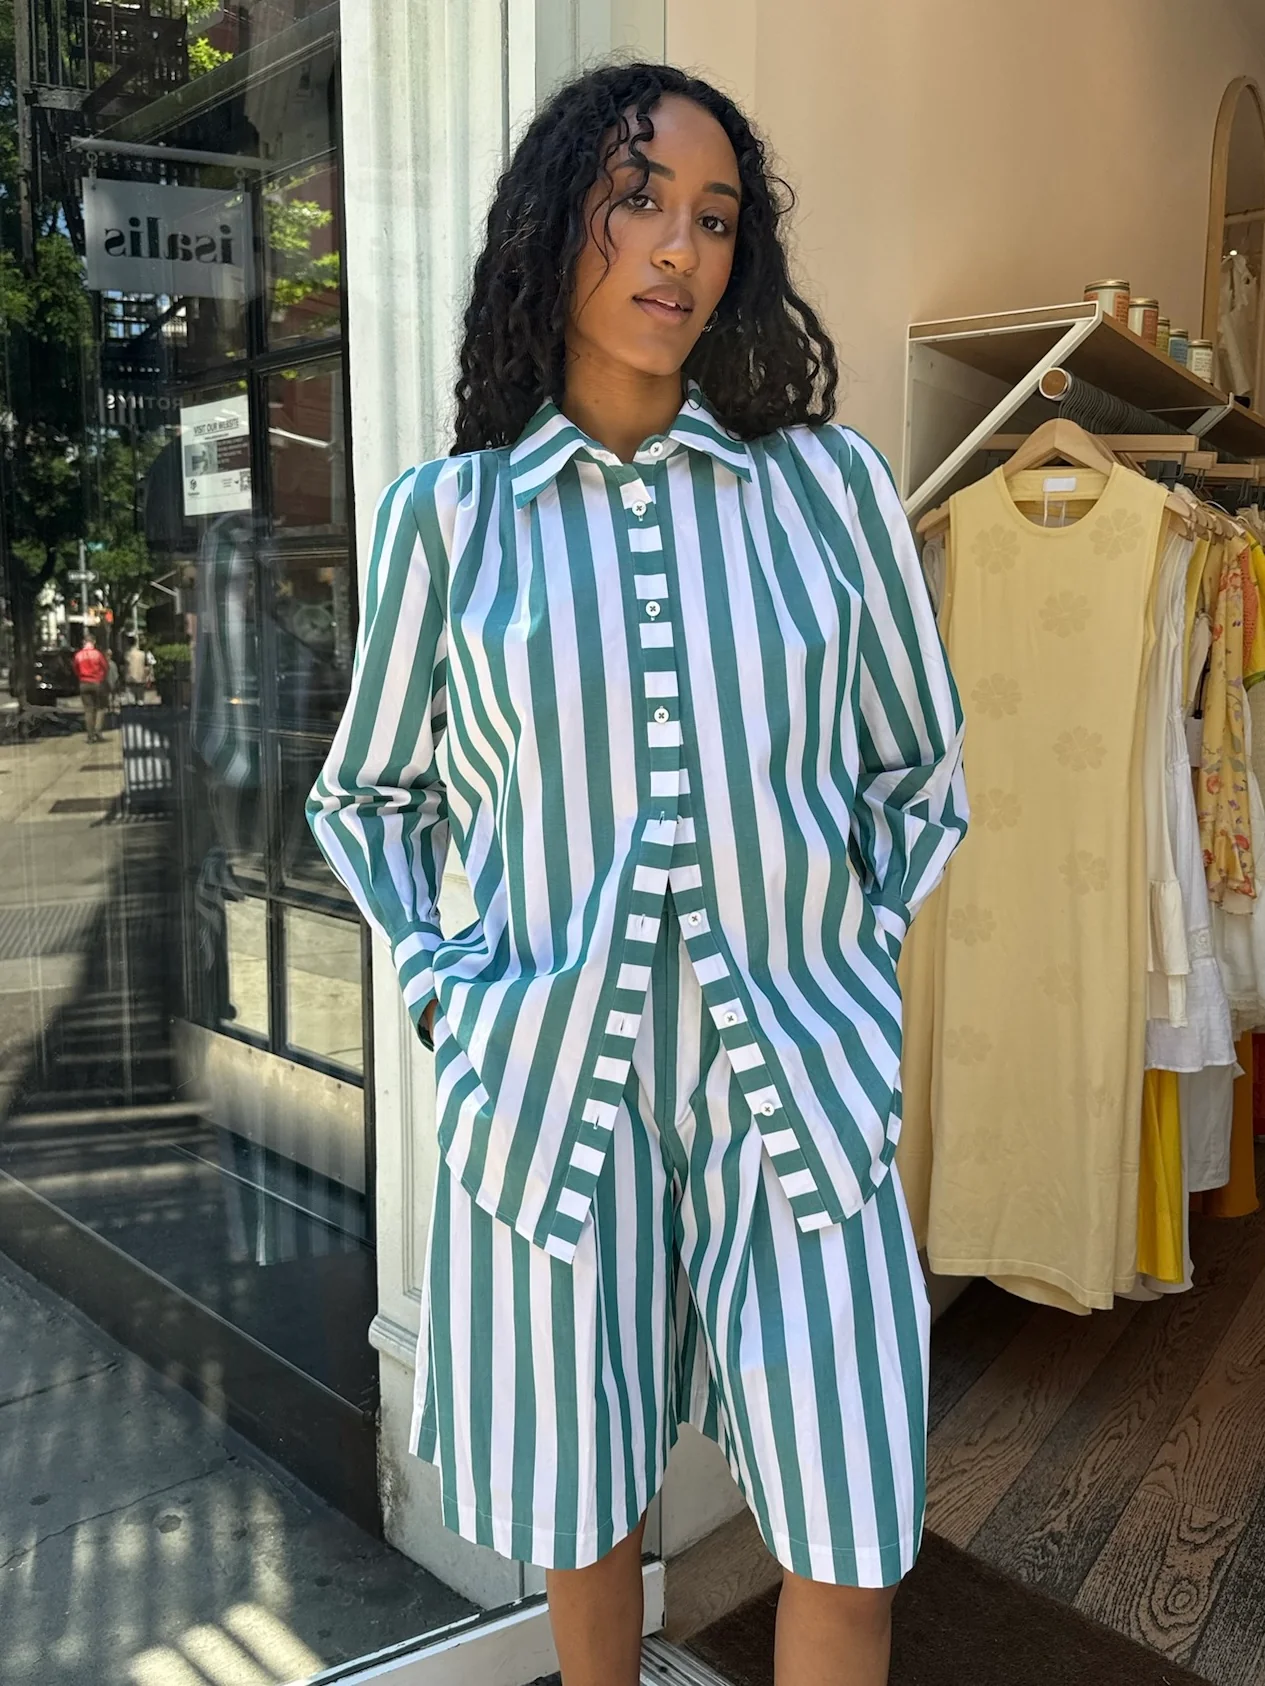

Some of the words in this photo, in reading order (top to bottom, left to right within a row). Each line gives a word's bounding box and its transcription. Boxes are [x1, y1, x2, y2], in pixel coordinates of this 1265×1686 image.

[193, 424, 206, 434] VISIT
[207, 422, 218, 432] OUR
[218, 417, 239, 430] WEBSITE
